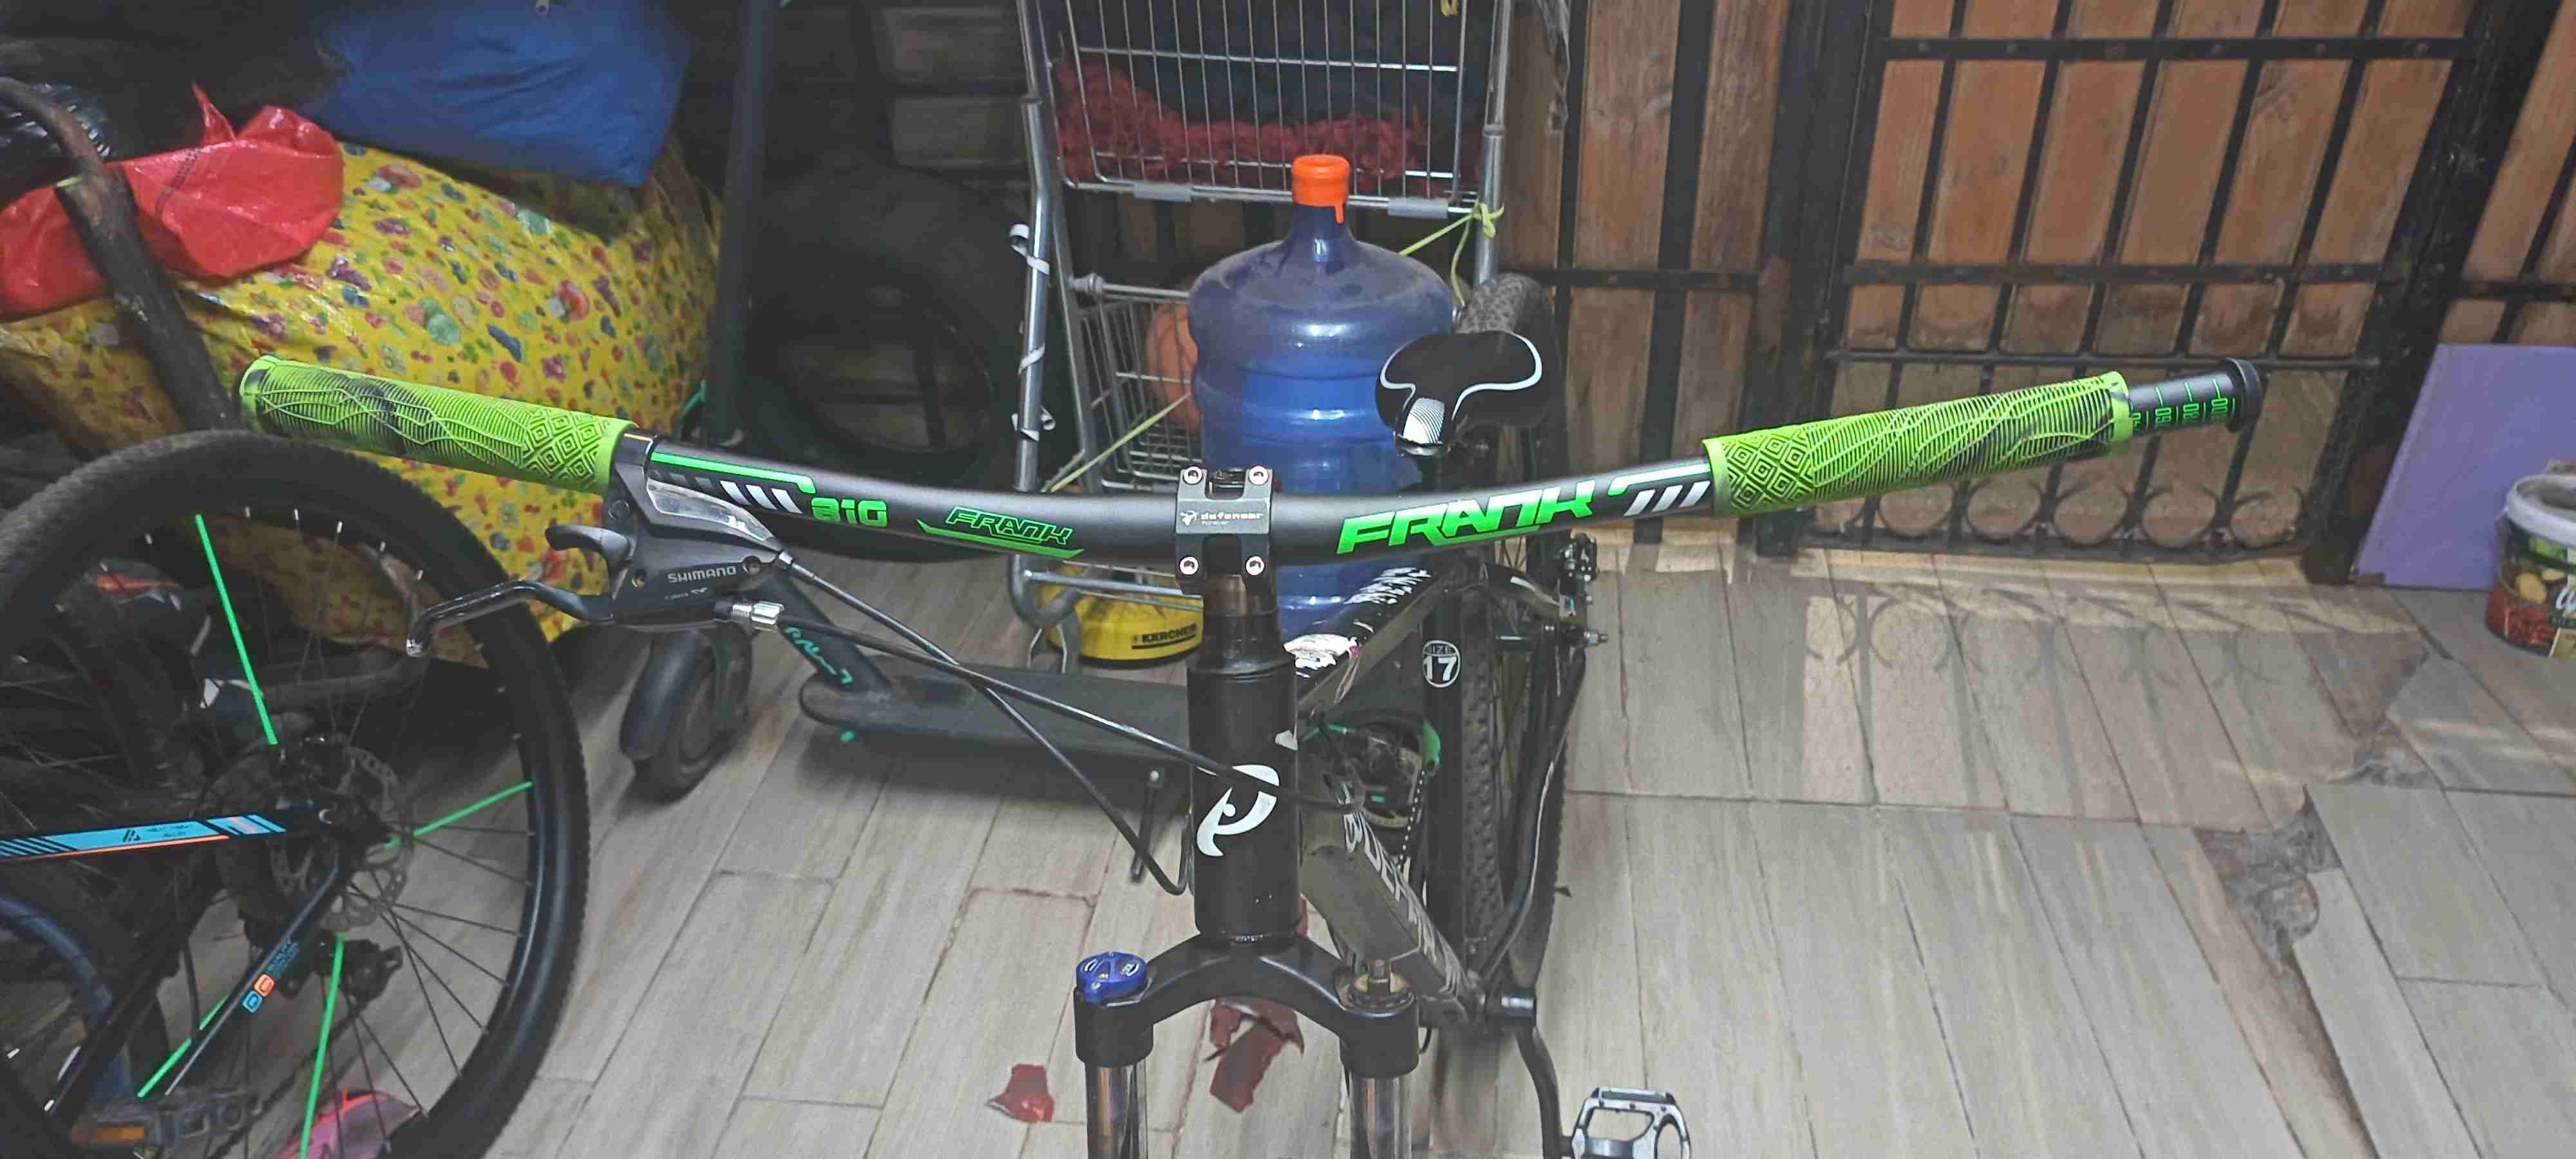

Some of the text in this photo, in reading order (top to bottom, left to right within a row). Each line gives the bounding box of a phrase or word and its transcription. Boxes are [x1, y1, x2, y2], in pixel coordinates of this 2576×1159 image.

[945, 506, 1074, 545] FRANK
[1336, 479, 1596, 554] FRANK
[667, 566, 737, 583] SHIMANO
[1423, 655, 1457, 681] 17
